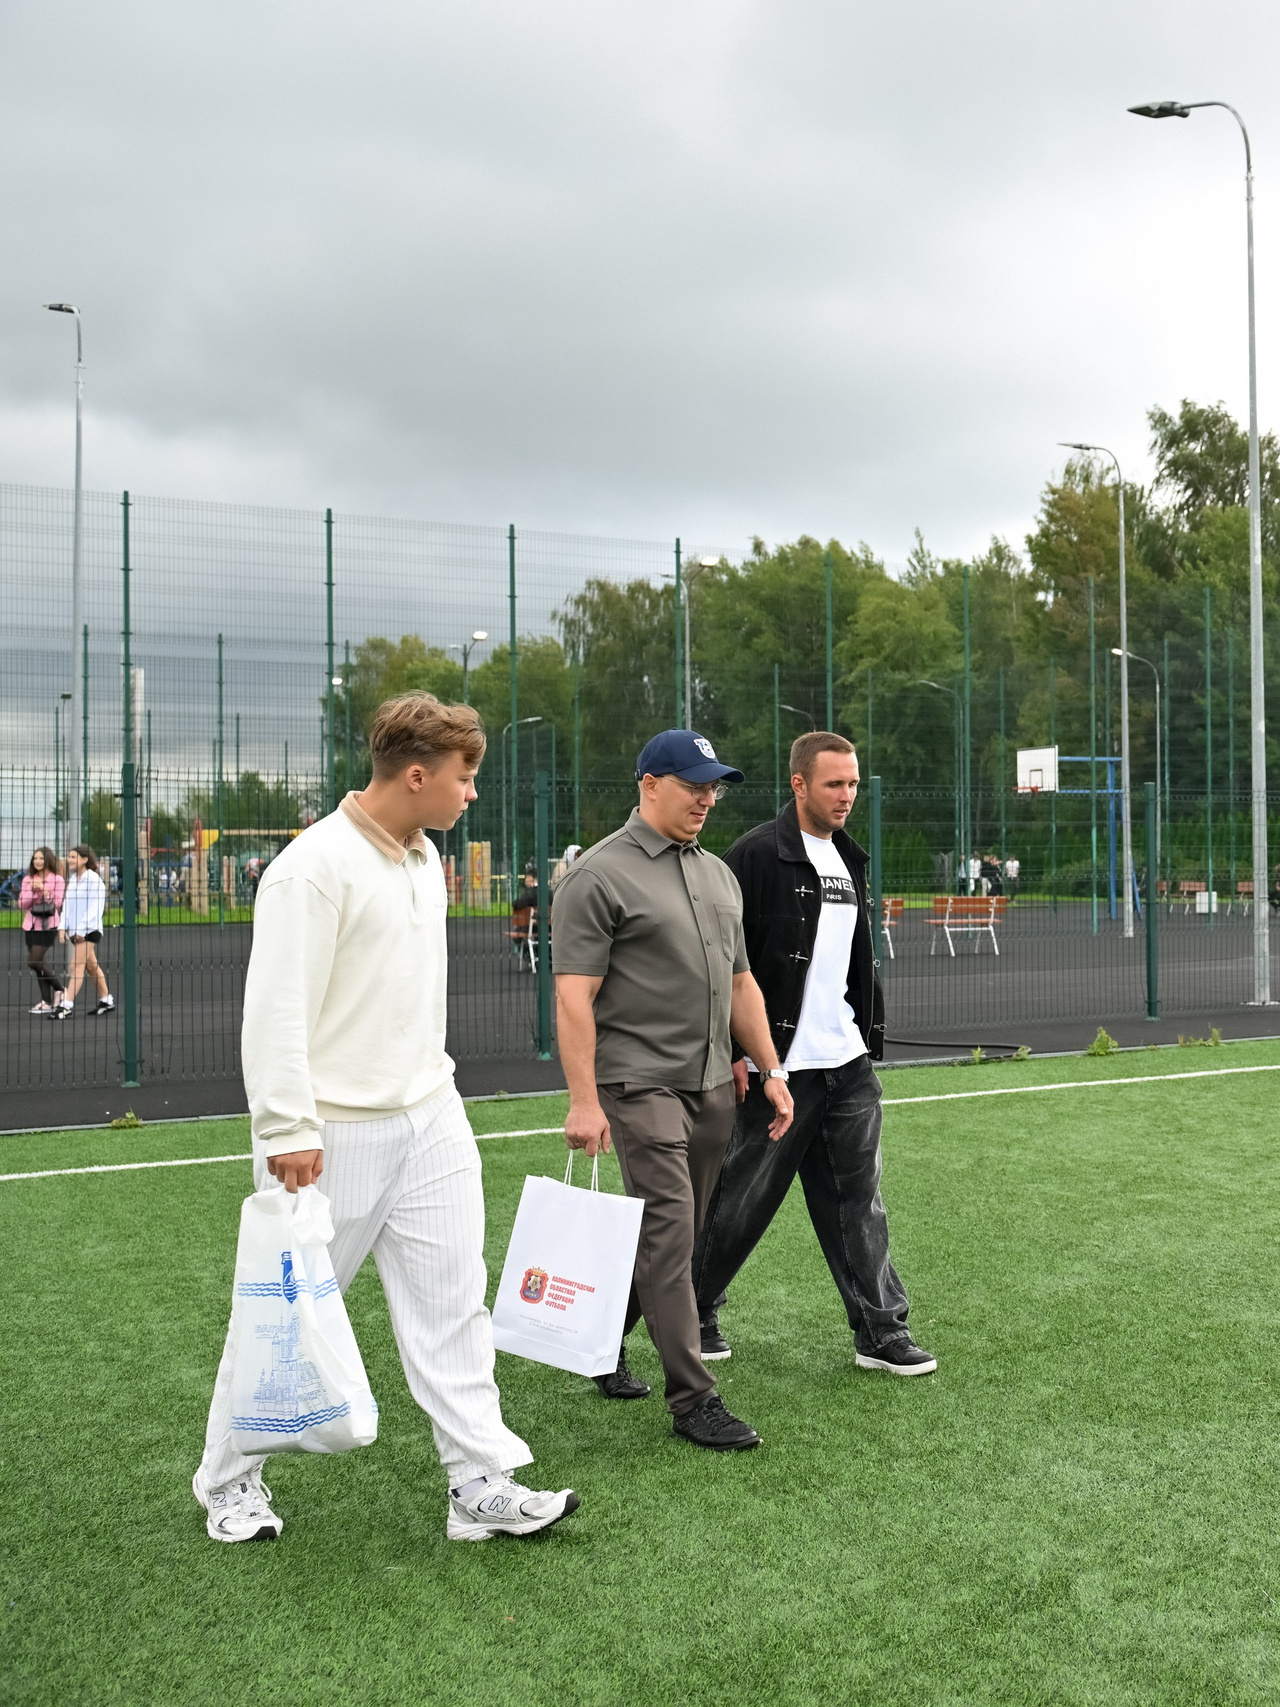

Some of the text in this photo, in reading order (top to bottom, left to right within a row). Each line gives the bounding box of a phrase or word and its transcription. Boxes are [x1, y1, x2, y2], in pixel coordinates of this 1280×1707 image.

[820, 878, 855, 893] ANEL
[547, 1292, 574, 1305] ФЕДЕРАЦИЯ
[545, 1301, 566, 1311] ФУТБОЛА
[488, 1495, 511, 1513] N
